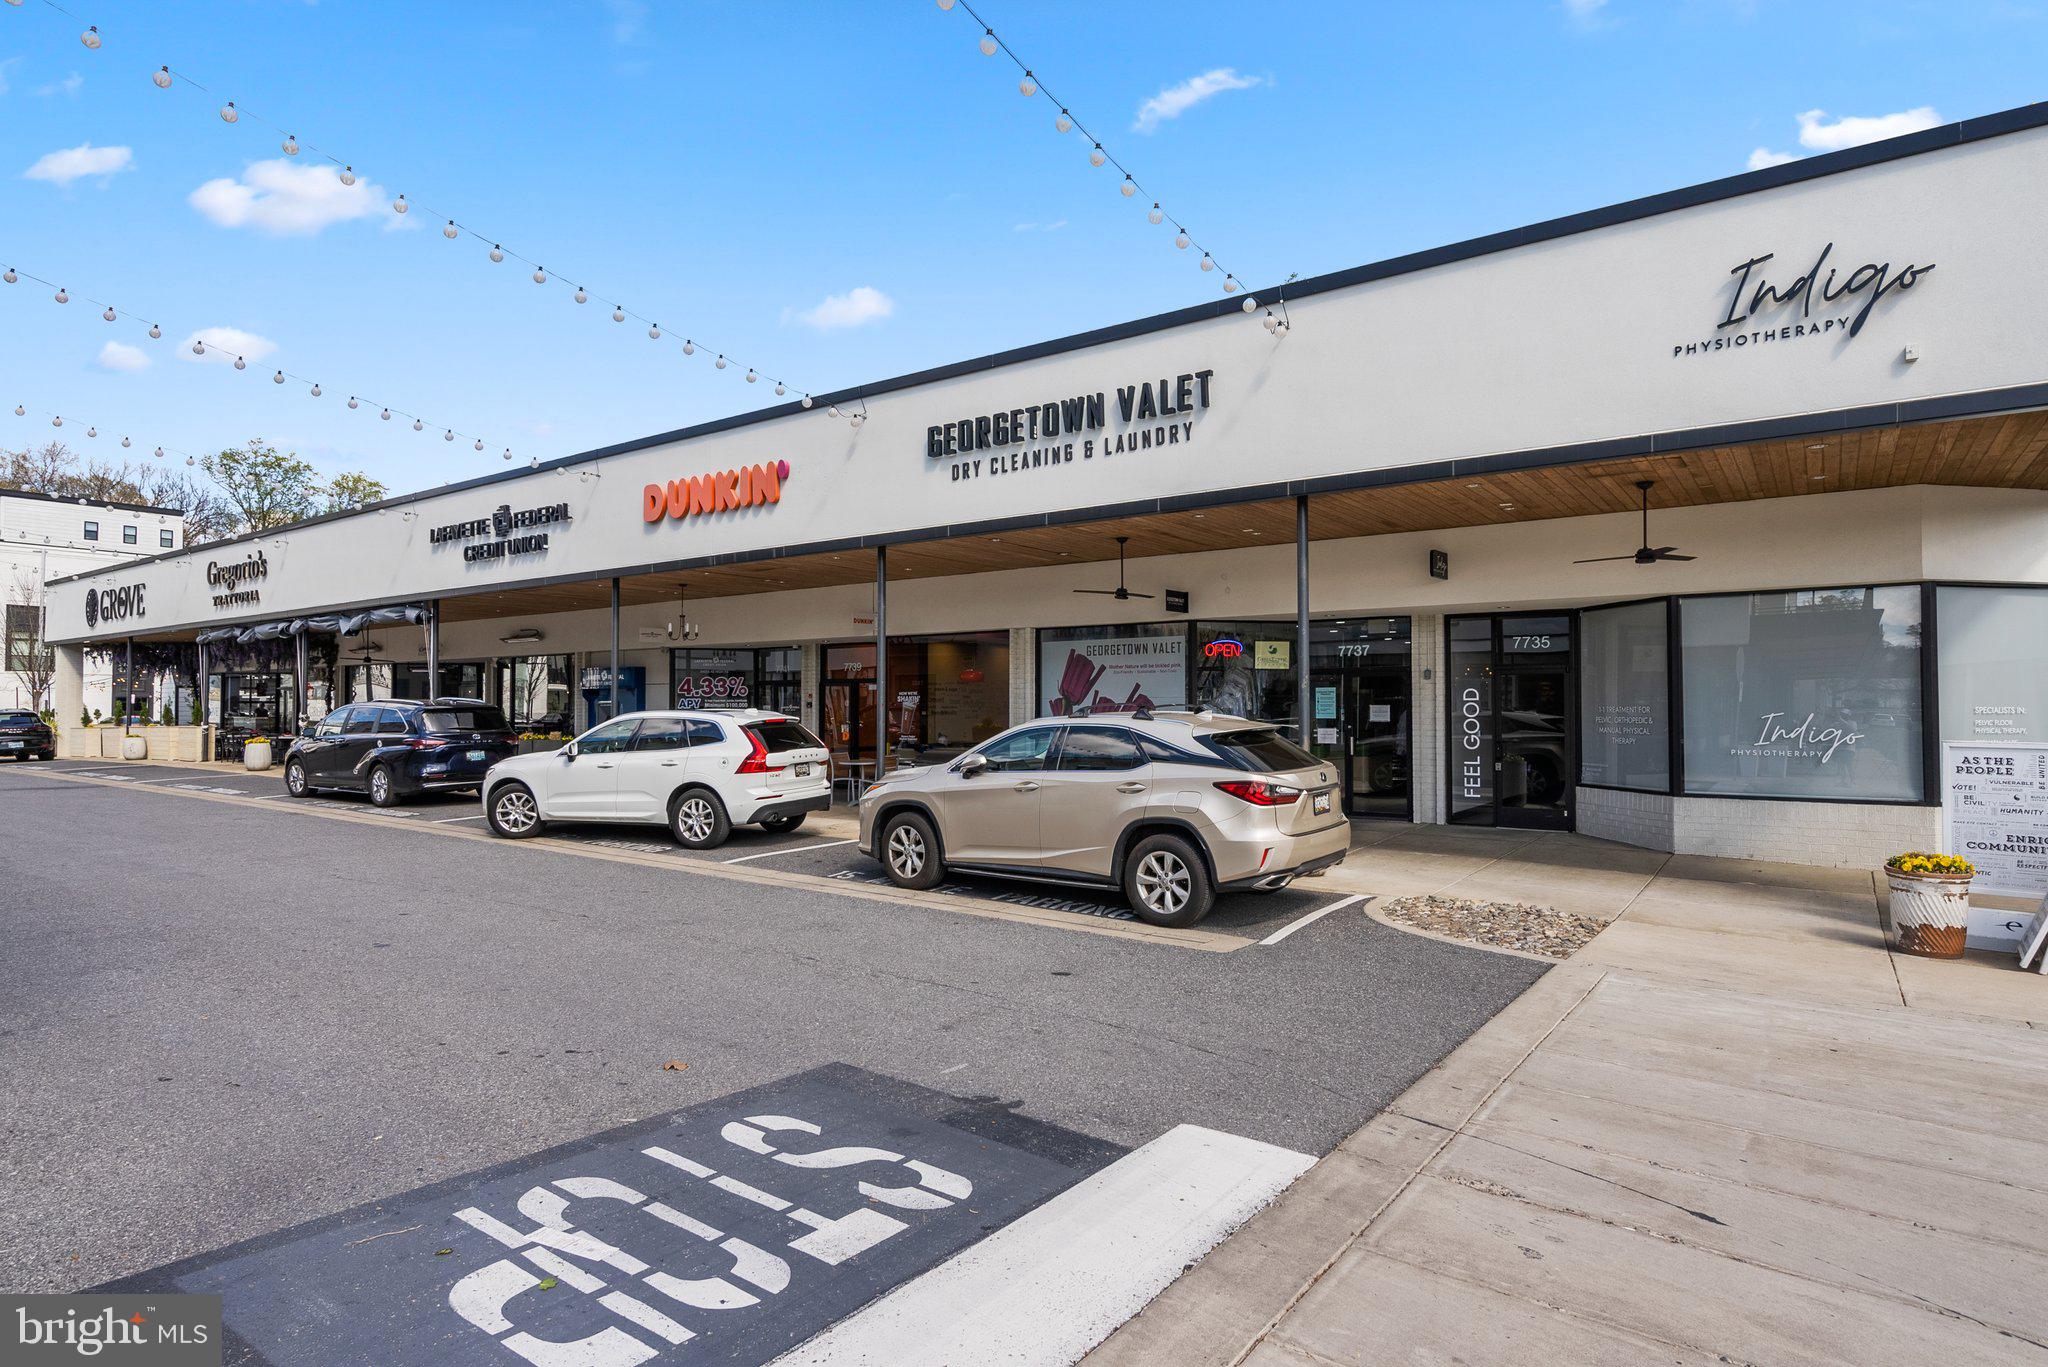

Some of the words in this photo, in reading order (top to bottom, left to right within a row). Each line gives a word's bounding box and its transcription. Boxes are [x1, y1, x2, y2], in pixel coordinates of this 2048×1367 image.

[1717, 242, 1936, 338] Indigo
[1673, 316, 1850, 357] PHYSIOTHERAPY
[927, 392, 1105, 458] GEORGETOWN
[1116, 369, 1213, 422] VALET
[951, 460, 981, 482] DRY
[990, 443, 1073, 475] CLEANING
[1084, 440, 1094, 458] &
[1104, 421, 1193, 456] LAUNDRY
[643, 459, 790, 524] DUNKIN'
[430, 518, 491, 544] LAFAYETTE
[513, 502, 573, 528] FEDERAL
[463, 540, 507, 562] CREDIT
[507, 533, 548, 555] UNION
[207, 550, 268, 590] Gregorio's
[100, 583, 147, 622] GROVE
[212, 589, 260, 607] TRATTORIA
[1086, 643, 1148, 657] GEORGETOWN
[1152, 641, 1182, 654] VALET
[1205, 643, 1241, 658] OPEN
[1338, 644, 1370, 657] 7737
[1513, 635, 1551, 649] 7735
[843, 662, 862, 672] 7739
[678, 676, 749, 697] 4.33%
[678, 698, 702, 709] APY
[1638, 706, 1652, 714] FOR
[1974, 706, 2016, 714] SPECIALISTS
[1463, 687, 1480, 750] GOOD
[1612, 736, 1637, 745] THERAPY
[1754, 712, 1865, 764] Indigo
[1730, 749, 1823, 758] PHYSIOTHERAPY
[1961, 756, 1981, 766] AS
[1983, 756, 2015, 767] THE
[1955, 766, 2014, 777] PEOPLE
[2038, 755, 2046, 779] UNITED
[1463, 755, 1481, 799] FEEL
[1952, 783, 1977, 791] VOTE!
[2000, 808, 2045, 816] HUMANITY
[991, 891, 1136, 920] PARKING
